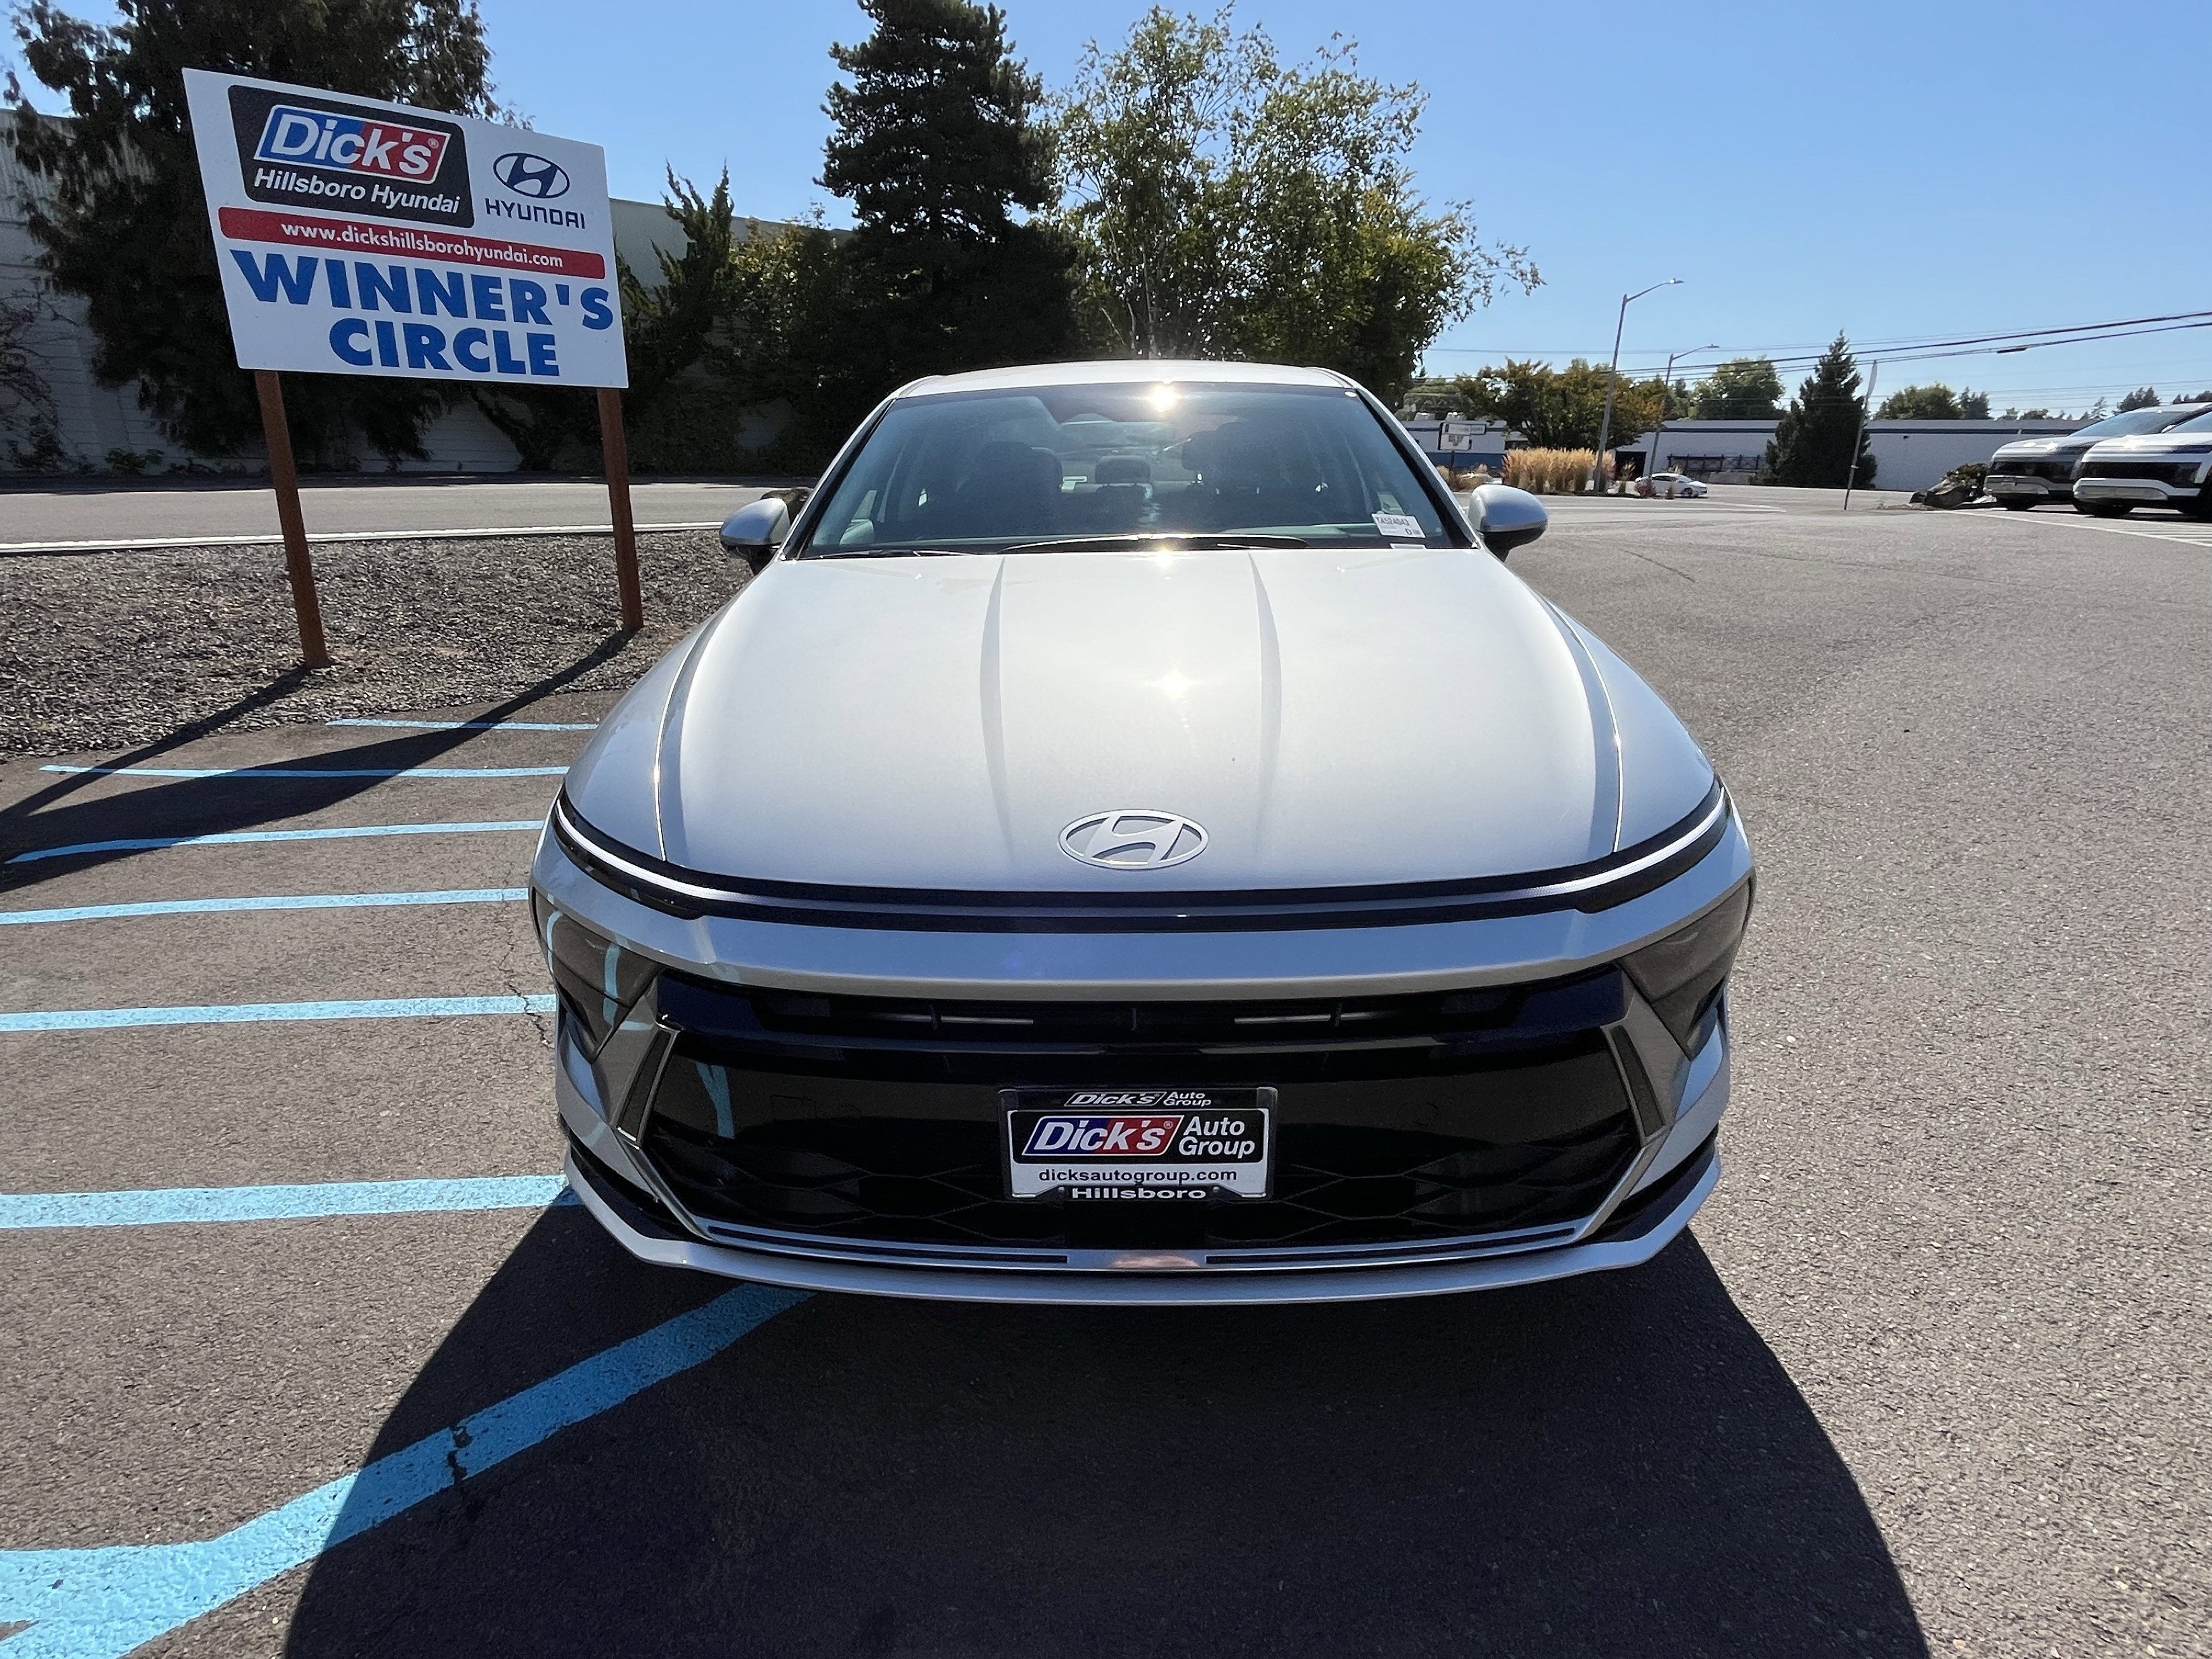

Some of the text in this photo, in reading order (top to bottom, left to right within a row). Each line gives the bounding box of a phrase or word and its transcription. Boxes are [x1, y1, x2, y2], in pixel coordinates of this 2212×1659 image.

[269, 113, 432, 174] Dick's
[254, 169, 460, 213] Hillsboro Hyundai
[486, 198, 585, 229] HYUNDAI
[281, 224, 563, 268] www.dickshillsborohyundai.com
[229, 249, 613, 330] WINNER'S
[329, 318, 560, 376] CIRCLE
[1071, 1093, 1155, 1104] Dick's
[1163, 1099, 1211, 1107] Group
[1034, 1120, 1165, 1151] Dick's
[1183, 1116, 1245, 1136] Auto
[1178, 1137, 1255, 1159] Group
[1039, 1169, 1238, 1184] dicksautogroup.com
[1072, 1186, 1207, 1199] Hillsboro
